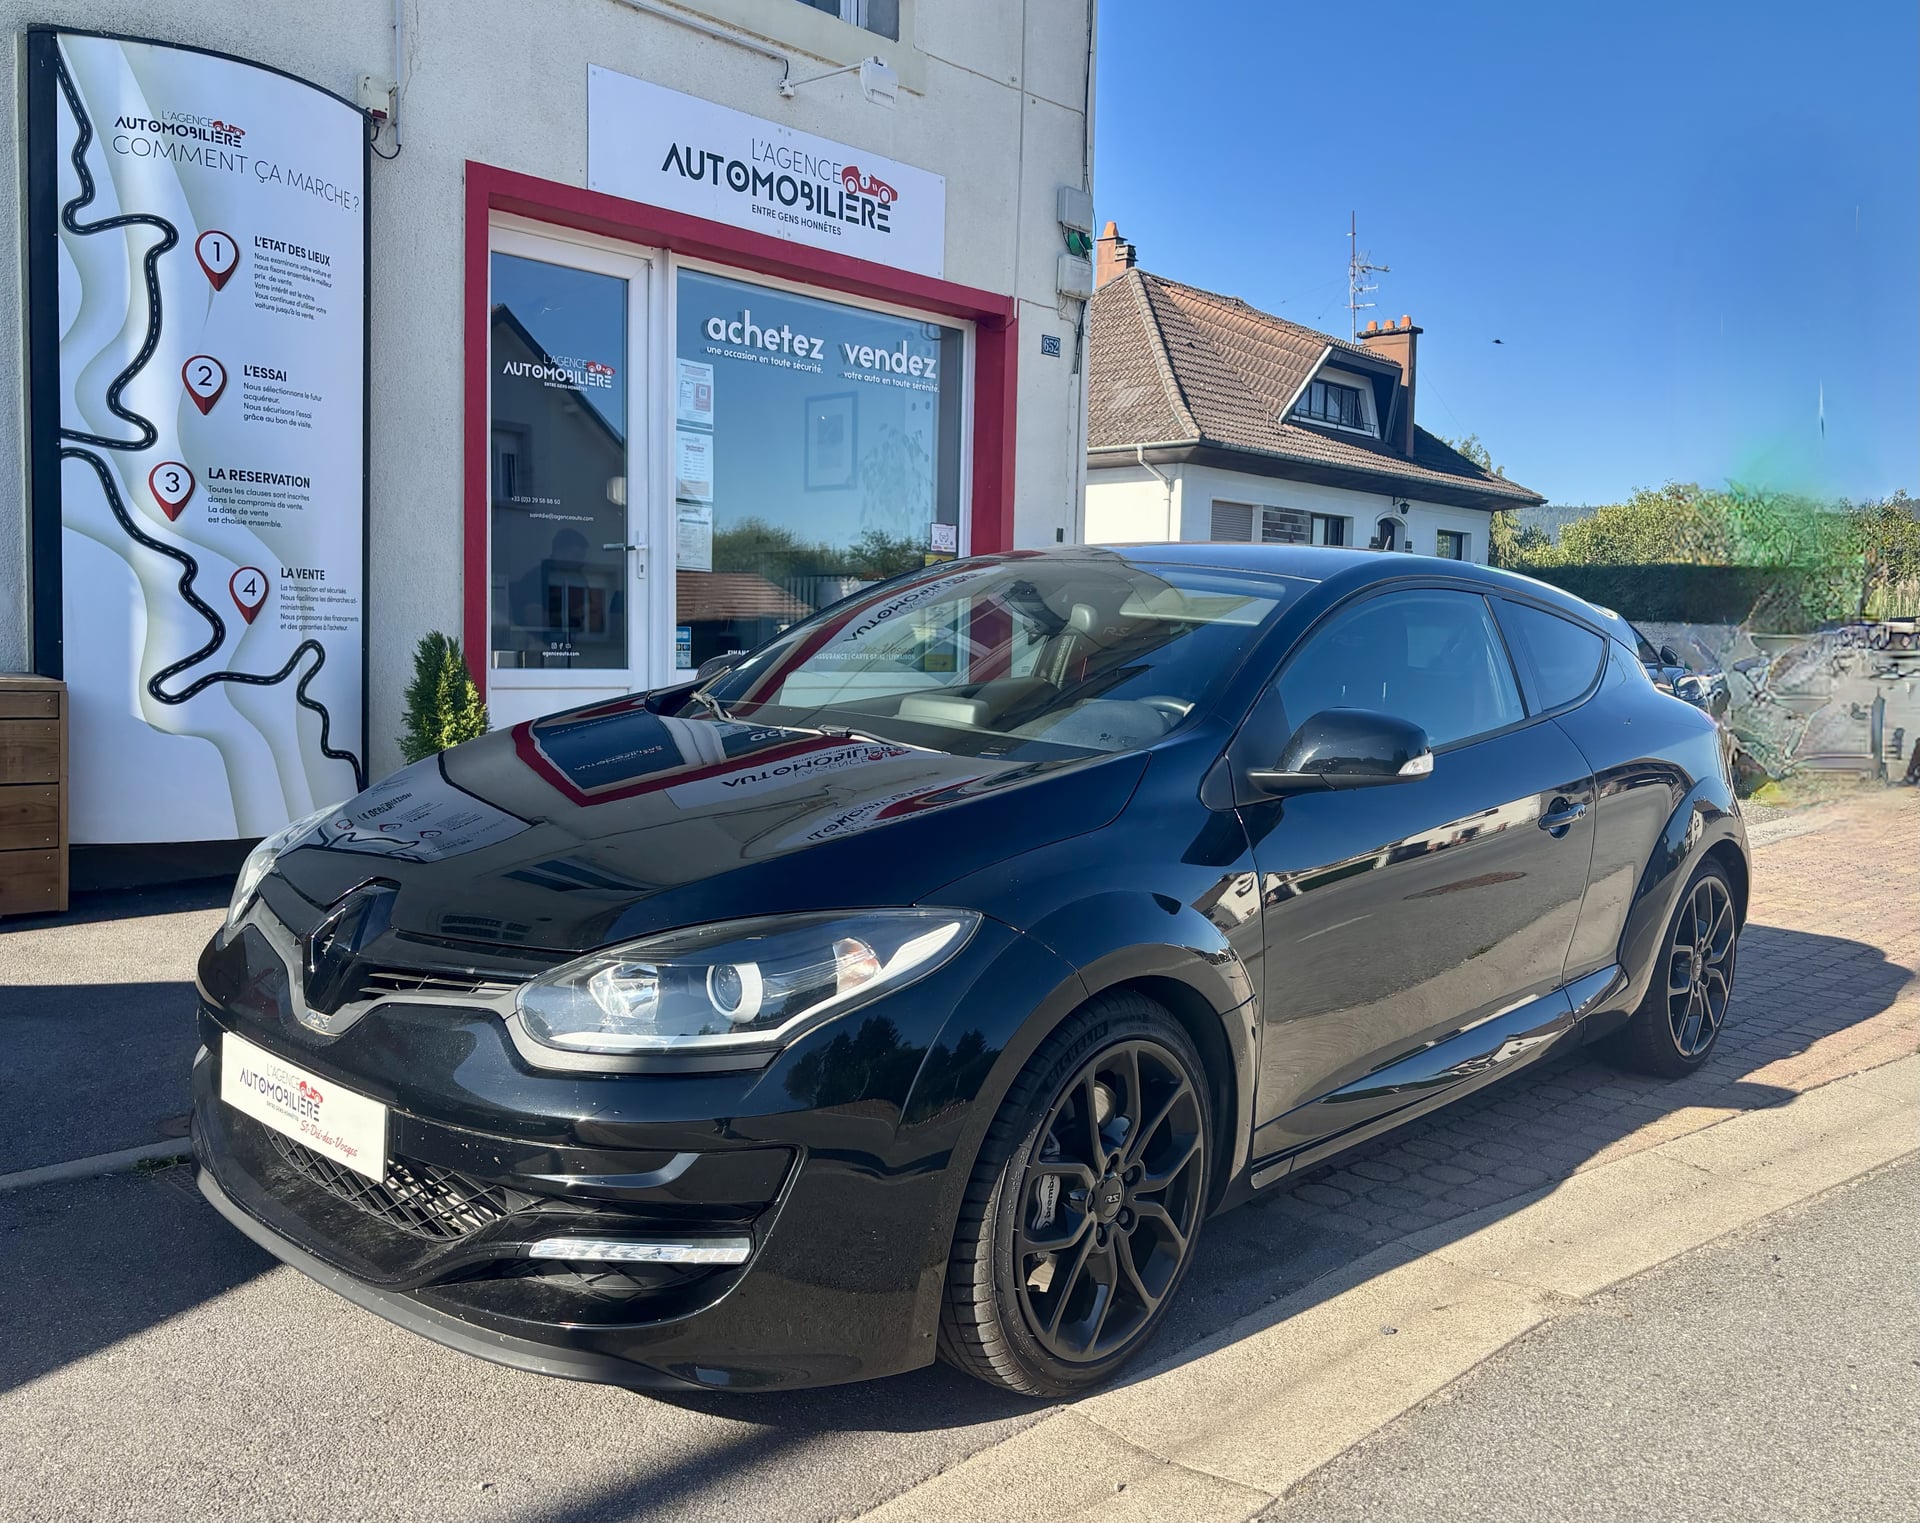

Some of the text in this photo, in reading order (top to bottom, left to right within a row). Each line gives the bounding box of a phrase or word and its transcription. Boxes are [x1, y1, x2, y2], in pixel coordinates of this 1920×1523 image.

[162, 111, 213, 127] L'AGENCE
[752, 138, 842, 184] L'AGENCE
[113, 135, 248, 173] COMMENT
[255, 161, 281, 183] ÇA
[288, 169, 350, 209] MARCHE
[752, 205, 841, 235] ENTRE GENS HONNÊTES
[213, 242, 220, 261] 1
[255, 236, 330, 266] L'ETAT DES LIEUX
[255, 253, 269, 261] Nous
[271, 257, 299, 269] examinons
[270, 266, 286, 275] fixons
[255, 282, 270, 290] Votre
[255, 292, 268, 300] Vous
[255, 302, 274, 311] voiture
[707, 310, 824, 360] achetez
[707, 346, 721, 355] une
[724, 349, 757, 362] occasion
[771, 356, 790, 368] toute
[793, 360, 823, 374] sécurité.
[844, 340, 937, 379] vendez
[198, 366, 212, 386] 2
[244, 365, 286, 381] L'ESSAI
[844, 370, 940, 393] votre auto en toute sérénité.
[244, 383, 261, 391] Nous
[263, 385, 303, 398] sélectionnons
[244, 393, 280, 404] acquéreur.
[244, 403, 261, 411] Nous
[263, 406, 294, 416] sécurisons
[244, 414, 264, 422] grâce
[276, 417, 287, 425] bon
[165, 472, 180, 493] 3
[208, 467, 310, 488] LA RESERVATION
[208, 485, 232, 494] Toutes
[246, 489, 271, 497] clauses
[208, 495, 227, 504] dans
[237, 499, 276, 508] compromis
[221, 517, 247, 526] choisie
[281, 568, 325, 580] LA VENTE
[243, 578, 256, 596] 4
[267, 1064, 300, 1089] L'AGENCE
[1105, 1193, 1120, 1203] RS
